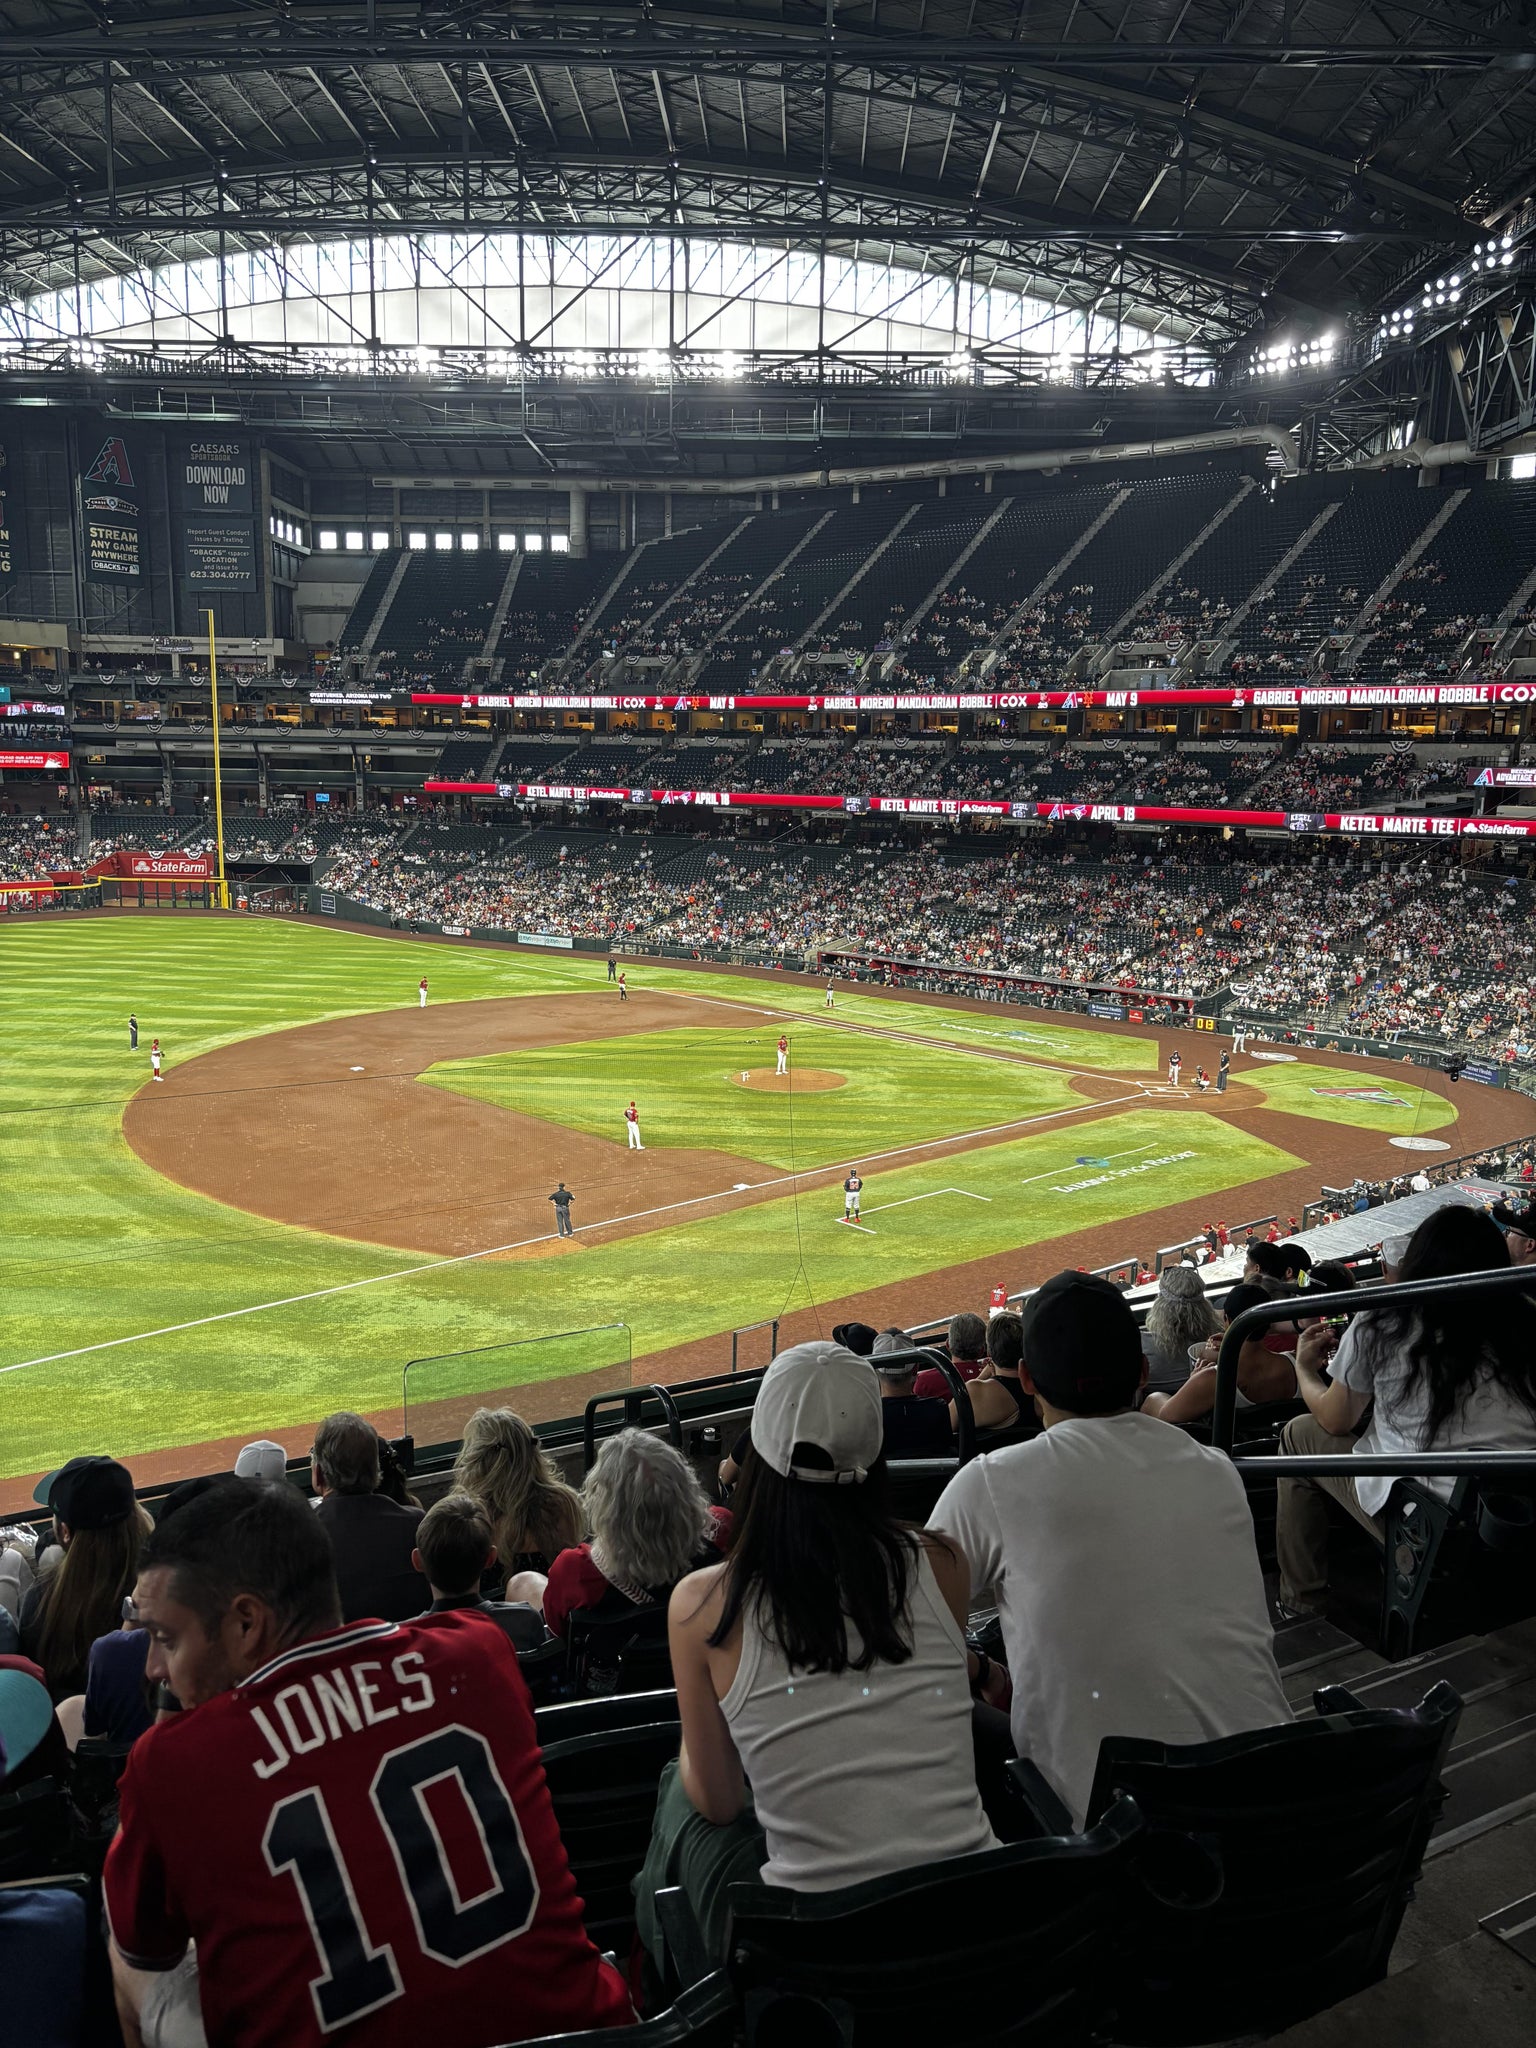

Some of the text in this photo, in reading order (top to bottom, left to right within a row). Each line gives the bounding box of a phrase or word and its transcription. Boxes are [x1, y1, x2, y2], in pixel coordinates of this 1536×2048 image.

[190, 443, 240, 454] CAESARS
[190, 453, 231, 461] SPORTSBOOK
[186, 465, 246, 485] DOWNLOAD
[204, 485, 229, 504] NOW
[90, 527, 138, 543] STREAM
[91, 540, 138, 552] ANY GAME
[91, 550, 139, 562] ANYWHERE
[190, 570, 250, 579] 623.304.0777
[478, 696, 618, 708] GABRIEL MORENO MANDALORIAN BOBBLE
[1000, 695, 1027, 708] COX
[1106, 692, 1138, 706] MAY 9
[1253, 686, 1488, 705] GABRIEL MORENO MANDALORIAN BOBBLE
[623, 697, 646, 708] COX
[710, 696, 735, 710] MAY 9
[824, 696, 992, 709] GABRIEL MORENO MANDALORIAN BOBBLE
[527, 786, 586, 798] KETEL MARTE TEE
[695, 792, 730, 805] APRIL 18
[880, 799, 957, 814] KETEL MARTE TEE
[1091, 806, 1135, 821] APRIL 18
[1340, 816, 1455, 834] KETEL MARTE TEE
[250, 1651, 435, 1779] JONES
[261, 1722, 541, 2035] 10
